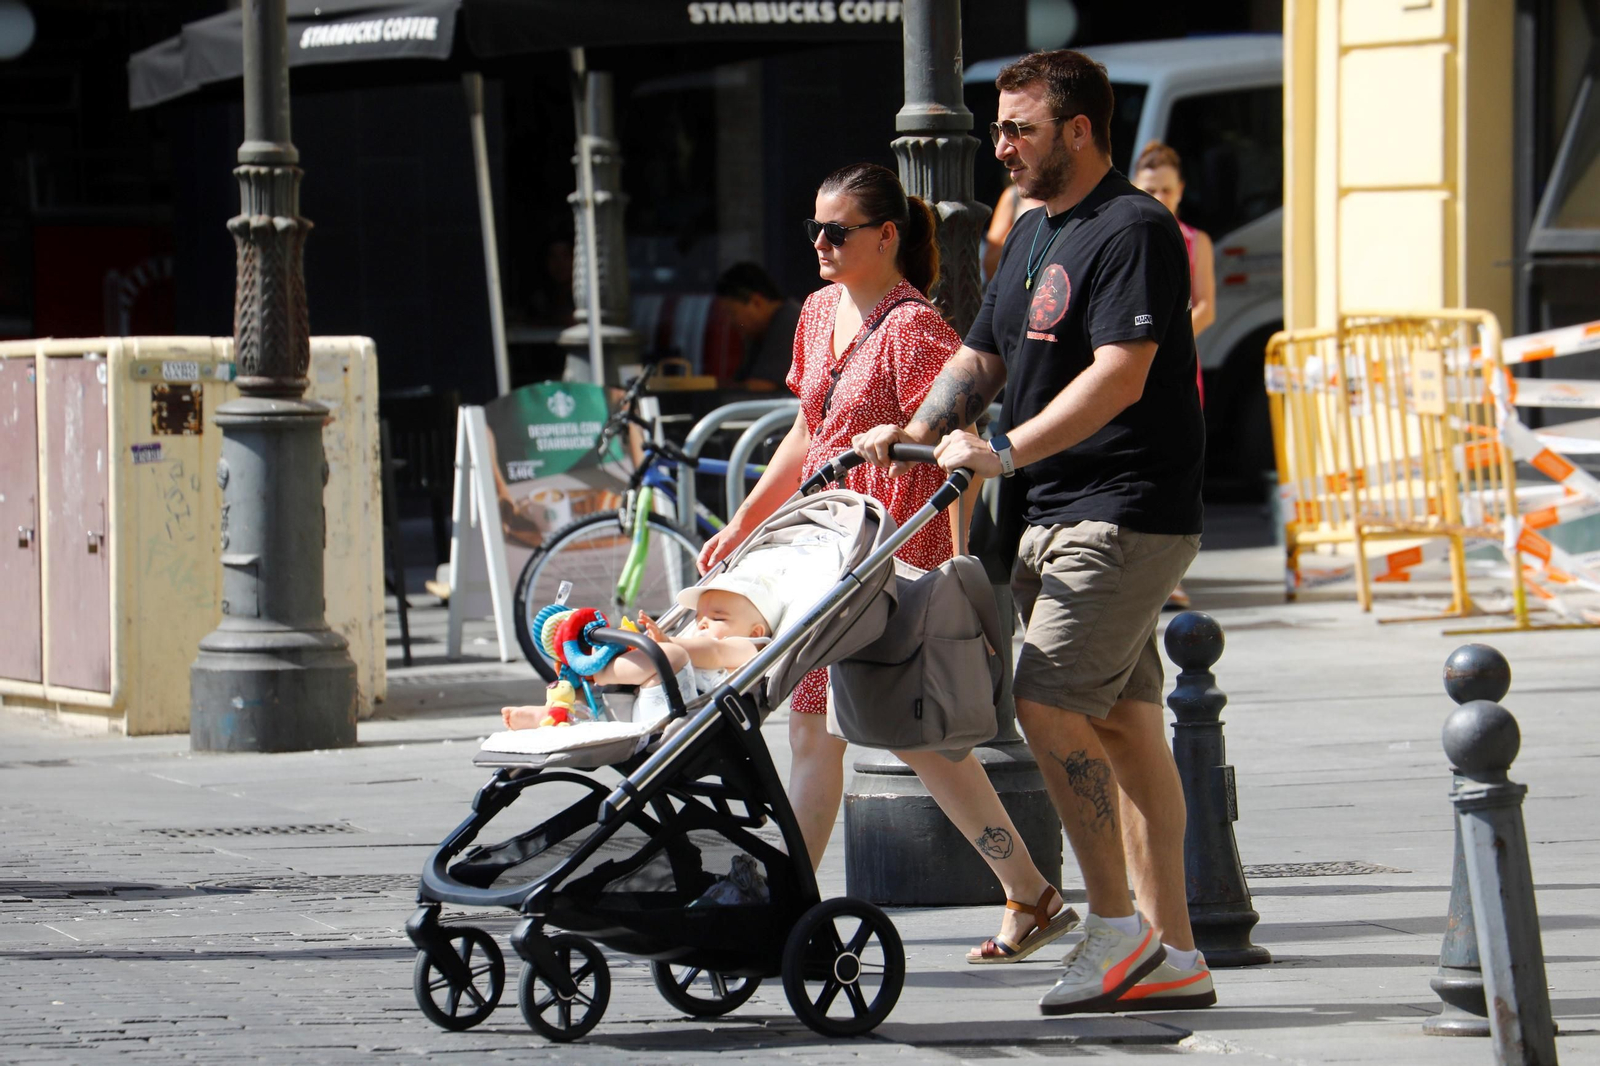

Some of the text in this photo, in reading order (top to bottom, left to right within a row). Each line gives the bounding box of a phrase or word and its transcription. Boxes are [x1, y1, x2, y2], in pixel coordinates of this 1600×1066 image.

[688, 1, 903, 23] STARBUCKS COFF
[300, 17, 438, 49] STARBUCKS COFFEE
[1135, 315, 1152, 325] MARV
[528, 421, 602, 438] DESPIERTA CON
[536, 436, 595, 450] STARBUCKS
